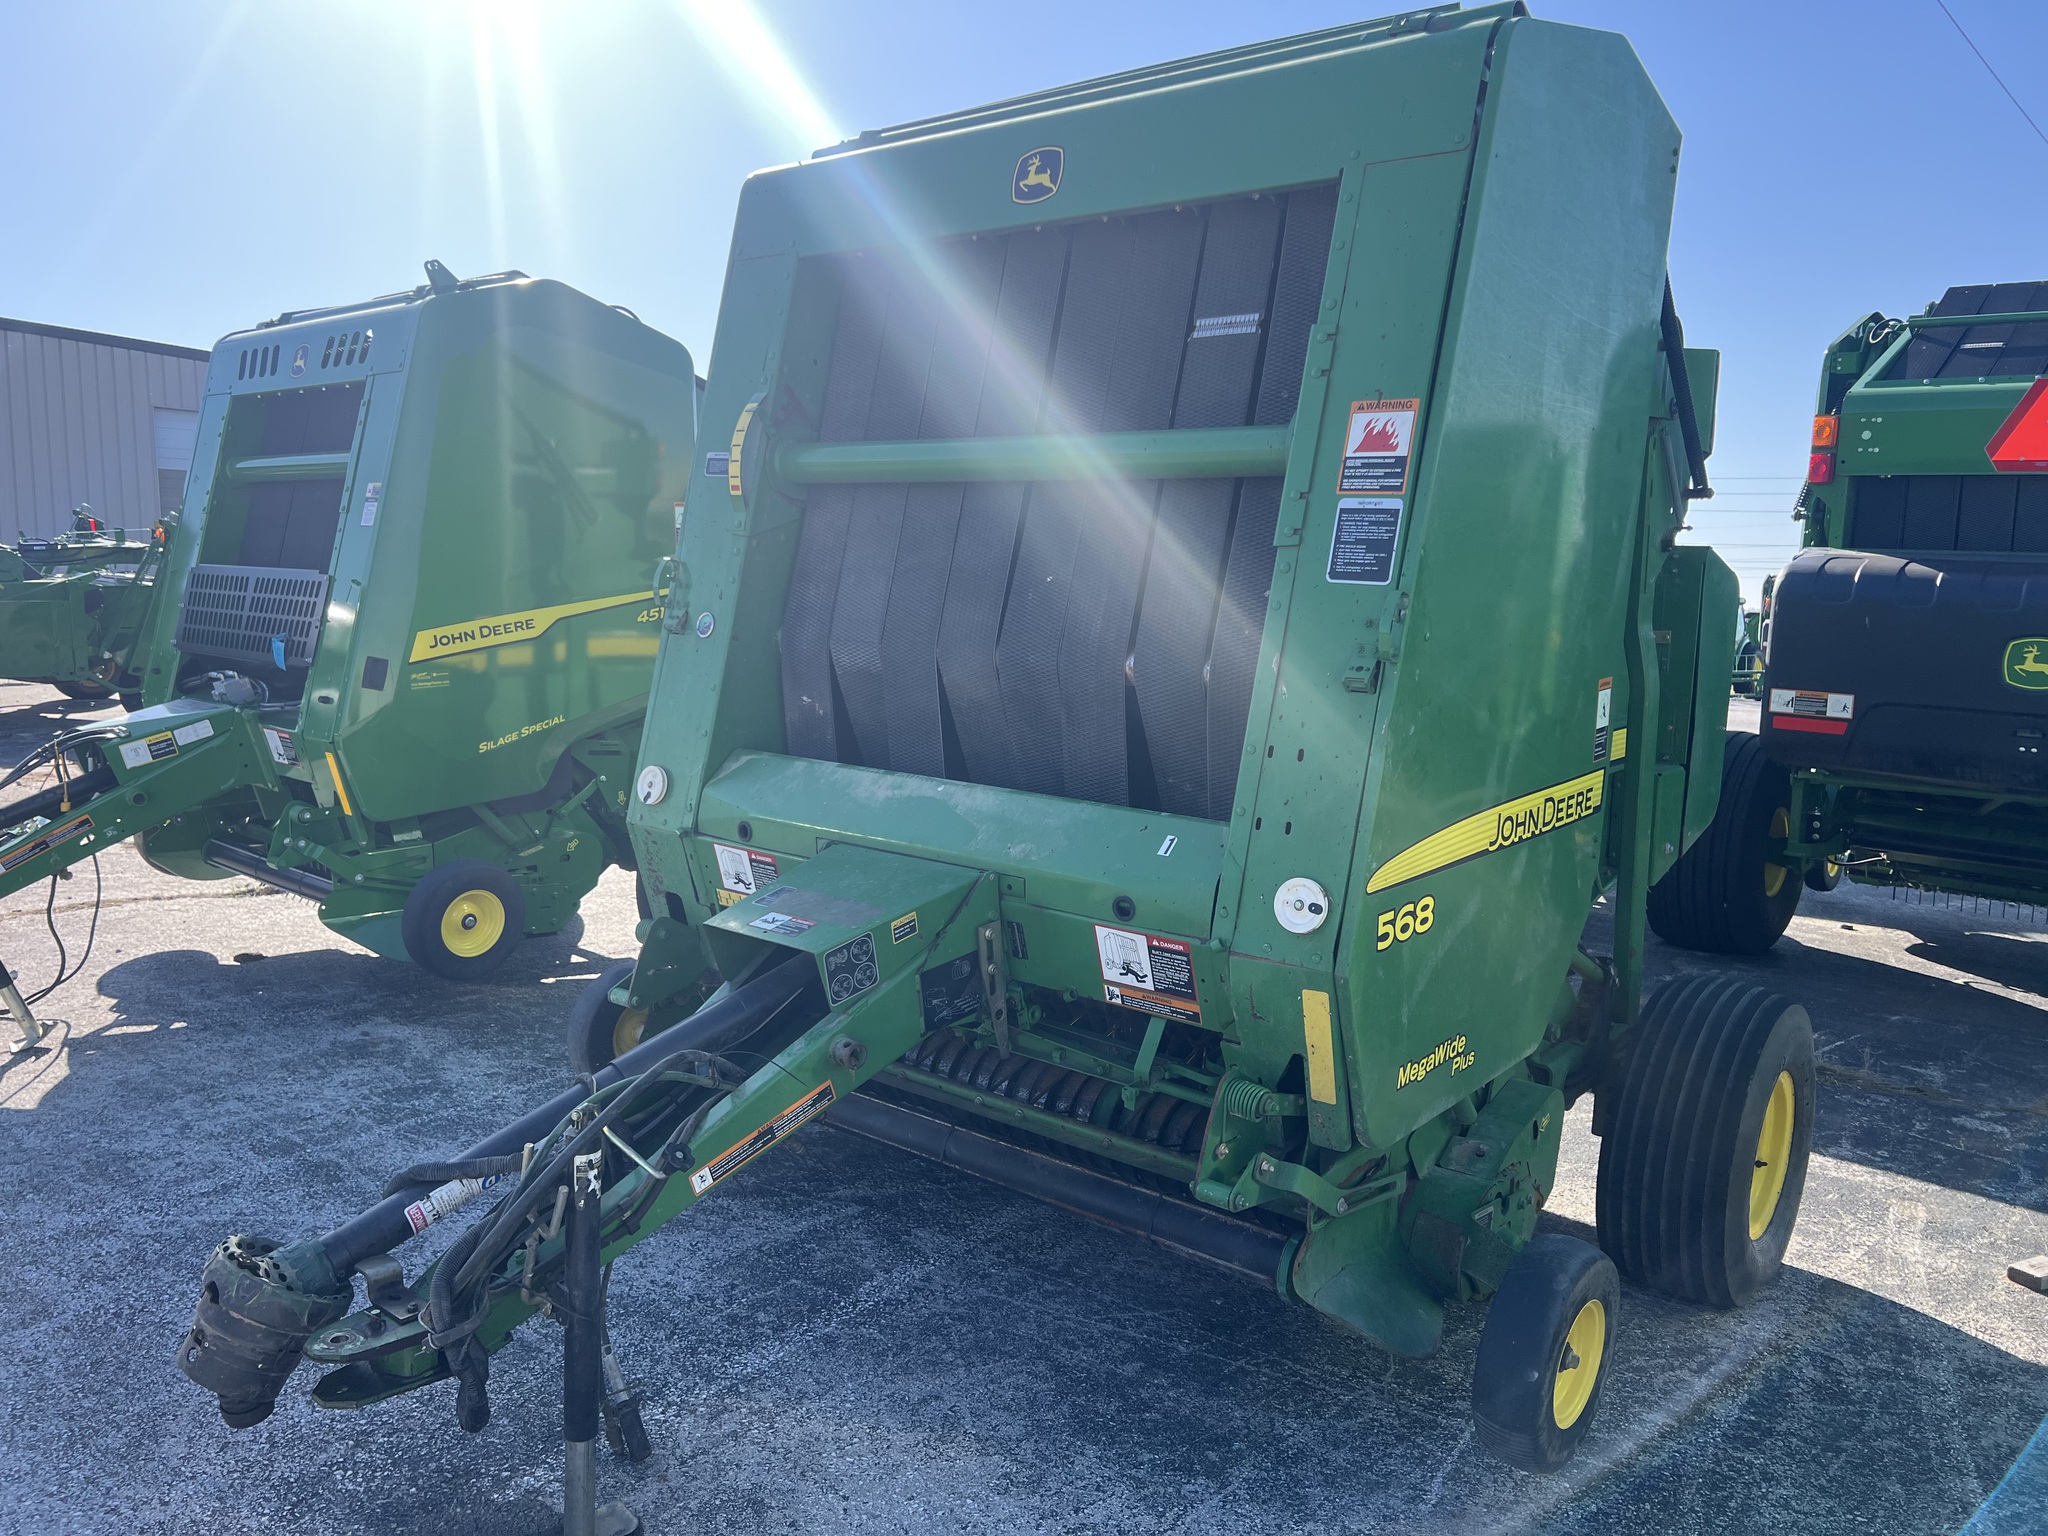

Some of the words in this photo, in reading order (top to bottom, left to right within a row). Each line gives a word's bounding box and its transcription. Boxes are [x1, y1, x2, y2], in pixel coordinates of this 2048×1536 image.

[1365, 399, 1413, 411] WARNING
[636, 606, 665, 623] 451
[429, 629, 476, 649] JOHN
[479, 618, 536, 639] DEERE
[479, 731, 519, 753] SILAGE
[521, 714, 566, 738] SPECIAL
[1488, 806, 1540, 848] JOHN
[1542, 787, 1594, 829] DEERE
[1377, 895, 1435, 951] 568
[1159, 941, 1184, 951] DANGER
[1146, 994, 1172, 1004] WARNING
[1397, 1034, 1466, 1090] MegaWide
[1451, 1051, 1476, 1077] Plus
[761, 1113, 785, 1131] WARNING
[410, 1206, 426, 1231] ANGER
